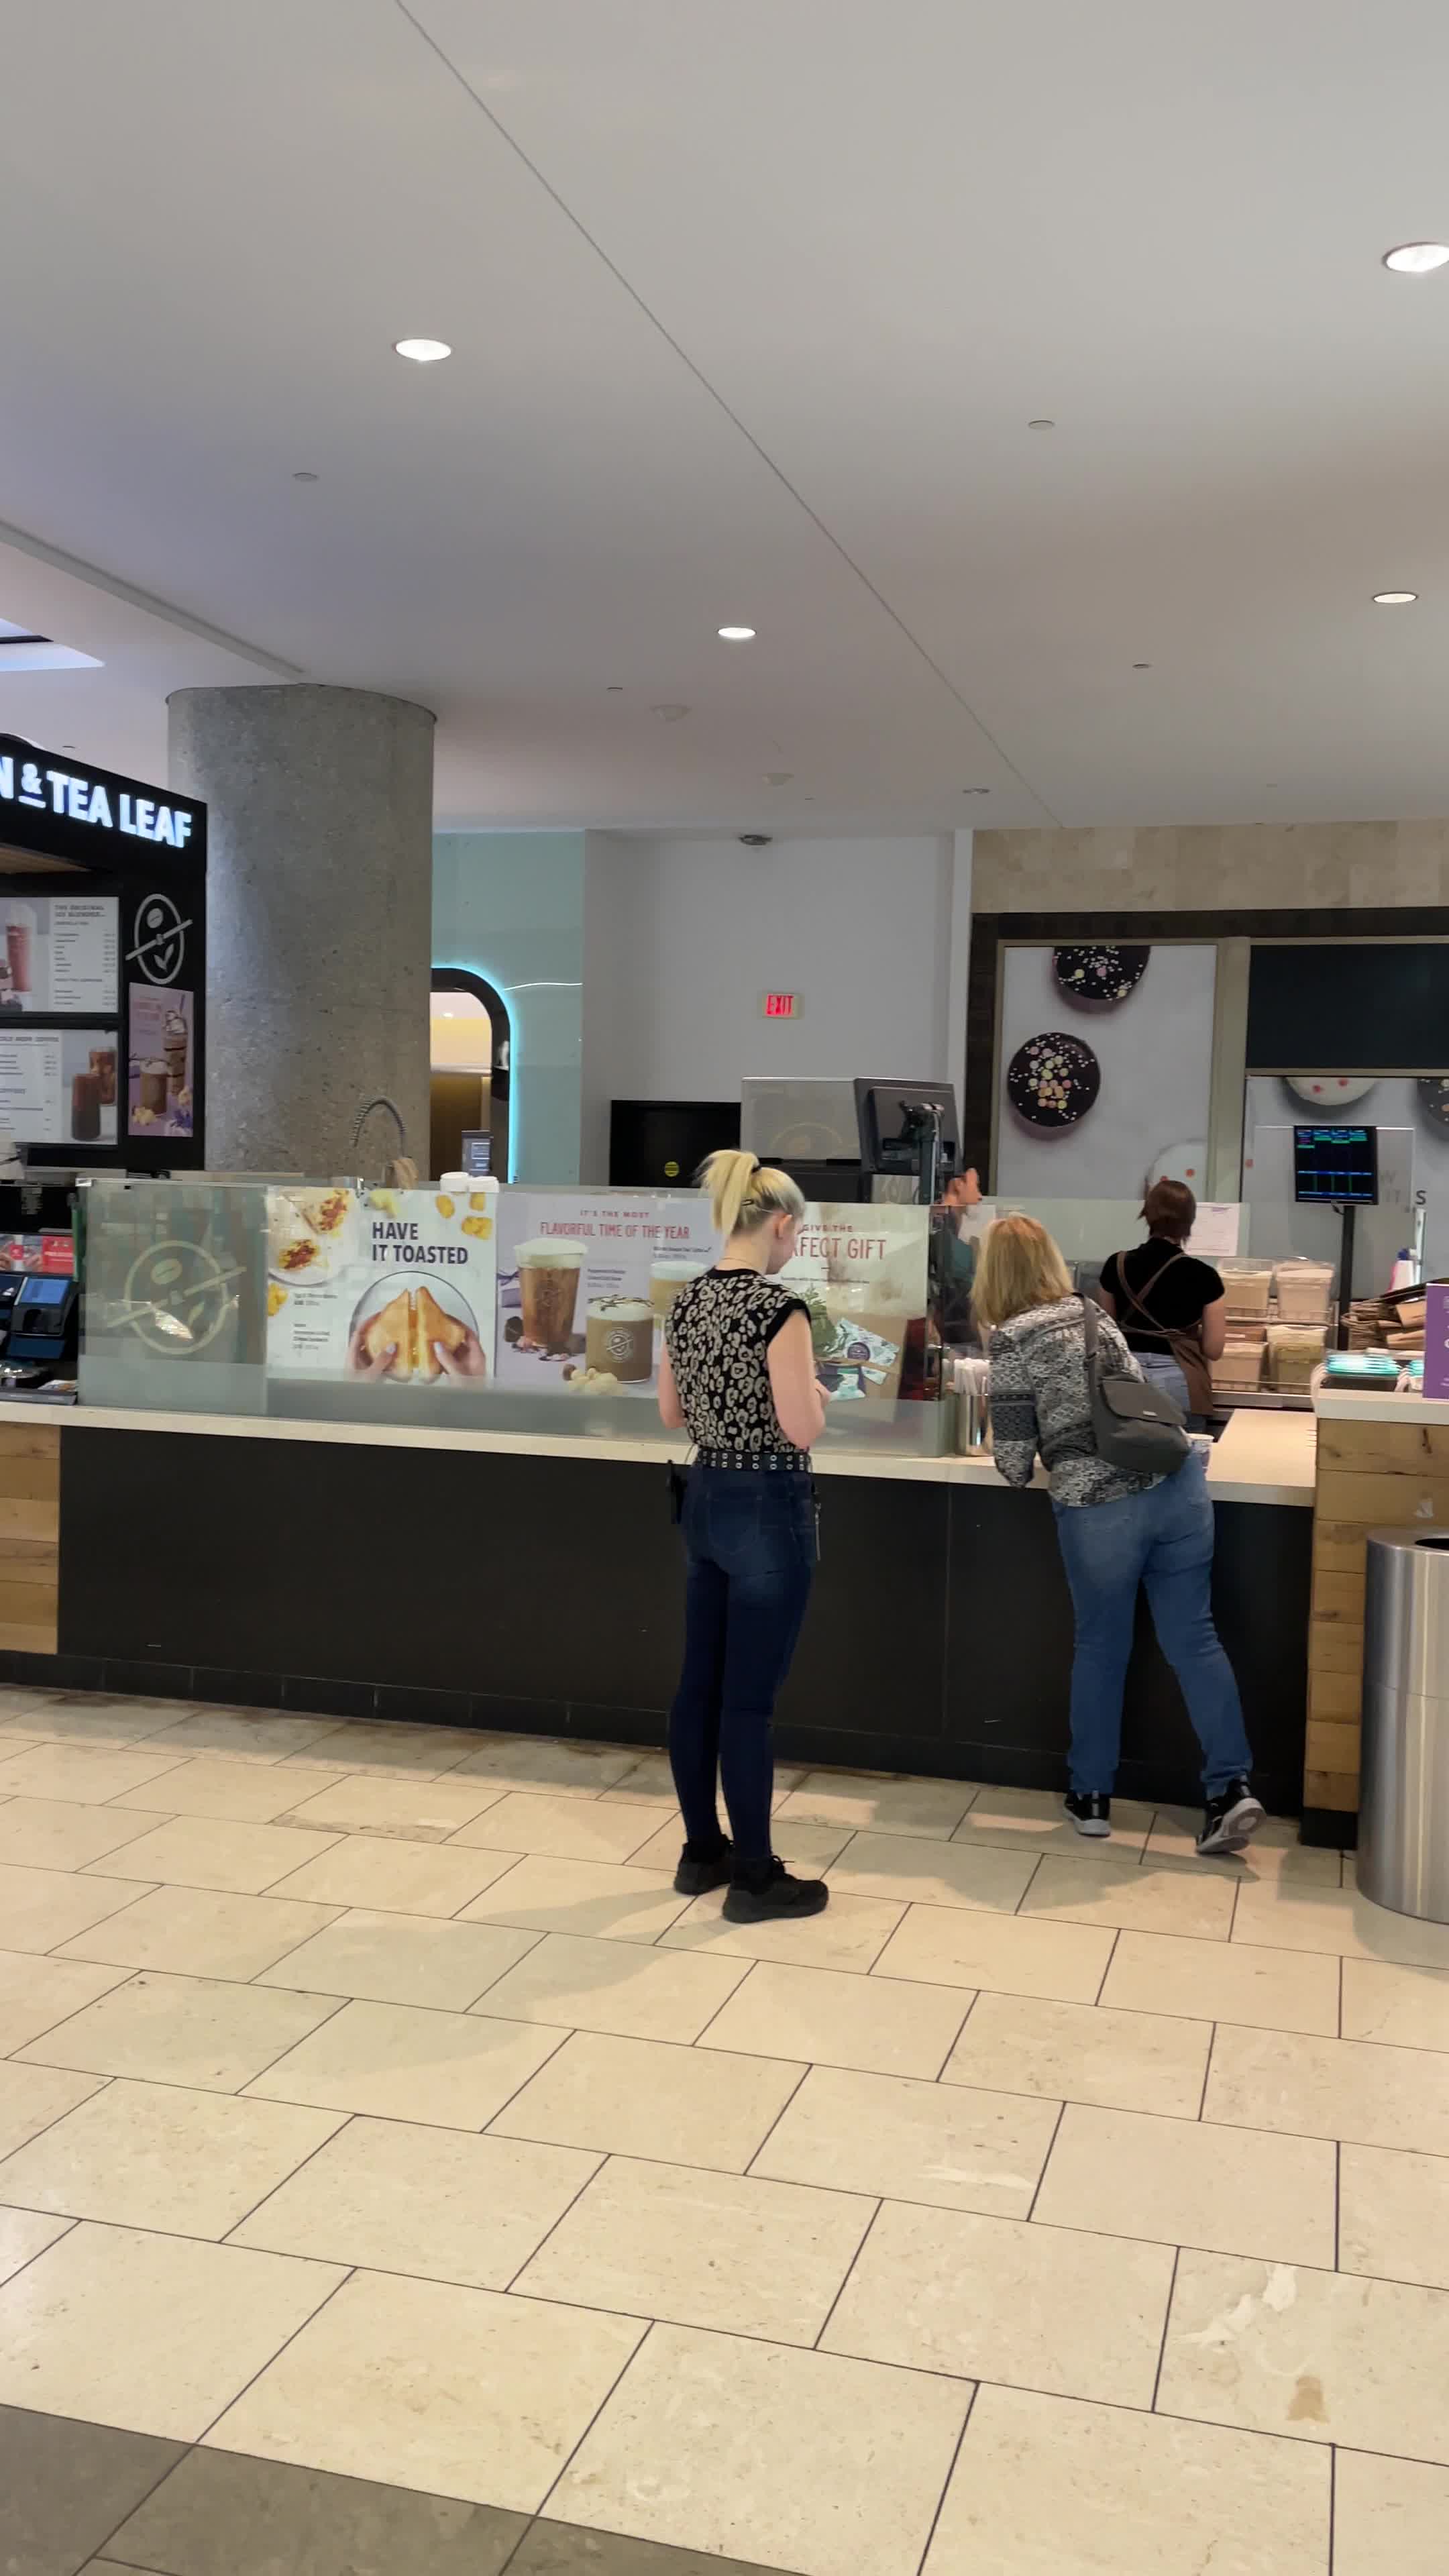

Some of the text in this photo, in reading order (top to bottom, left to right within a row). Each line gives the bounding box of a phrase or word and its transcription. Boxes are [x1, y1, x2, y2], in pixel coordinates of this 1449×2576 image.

[19, 763, 44, 806] &
[46, 769, 113, 828] TEA
[119, 793, 193, 849] LEAF
[767, 995, 794, 1015] EXIT
[372, 1221, 419, 1240] HAVE
[599, 1224, 623, 1237] TIME
[625, 1224, 639, 1238] OF
[641, 1225, 661, 1239] THE
[663, 1226, 691, 1240] YEAR
[802, 1224, 854, 1233] GIVE THE
[372, 1244, 469, 1265] IT TOASTED
[847, 1238, 887, 1260] GIFT
